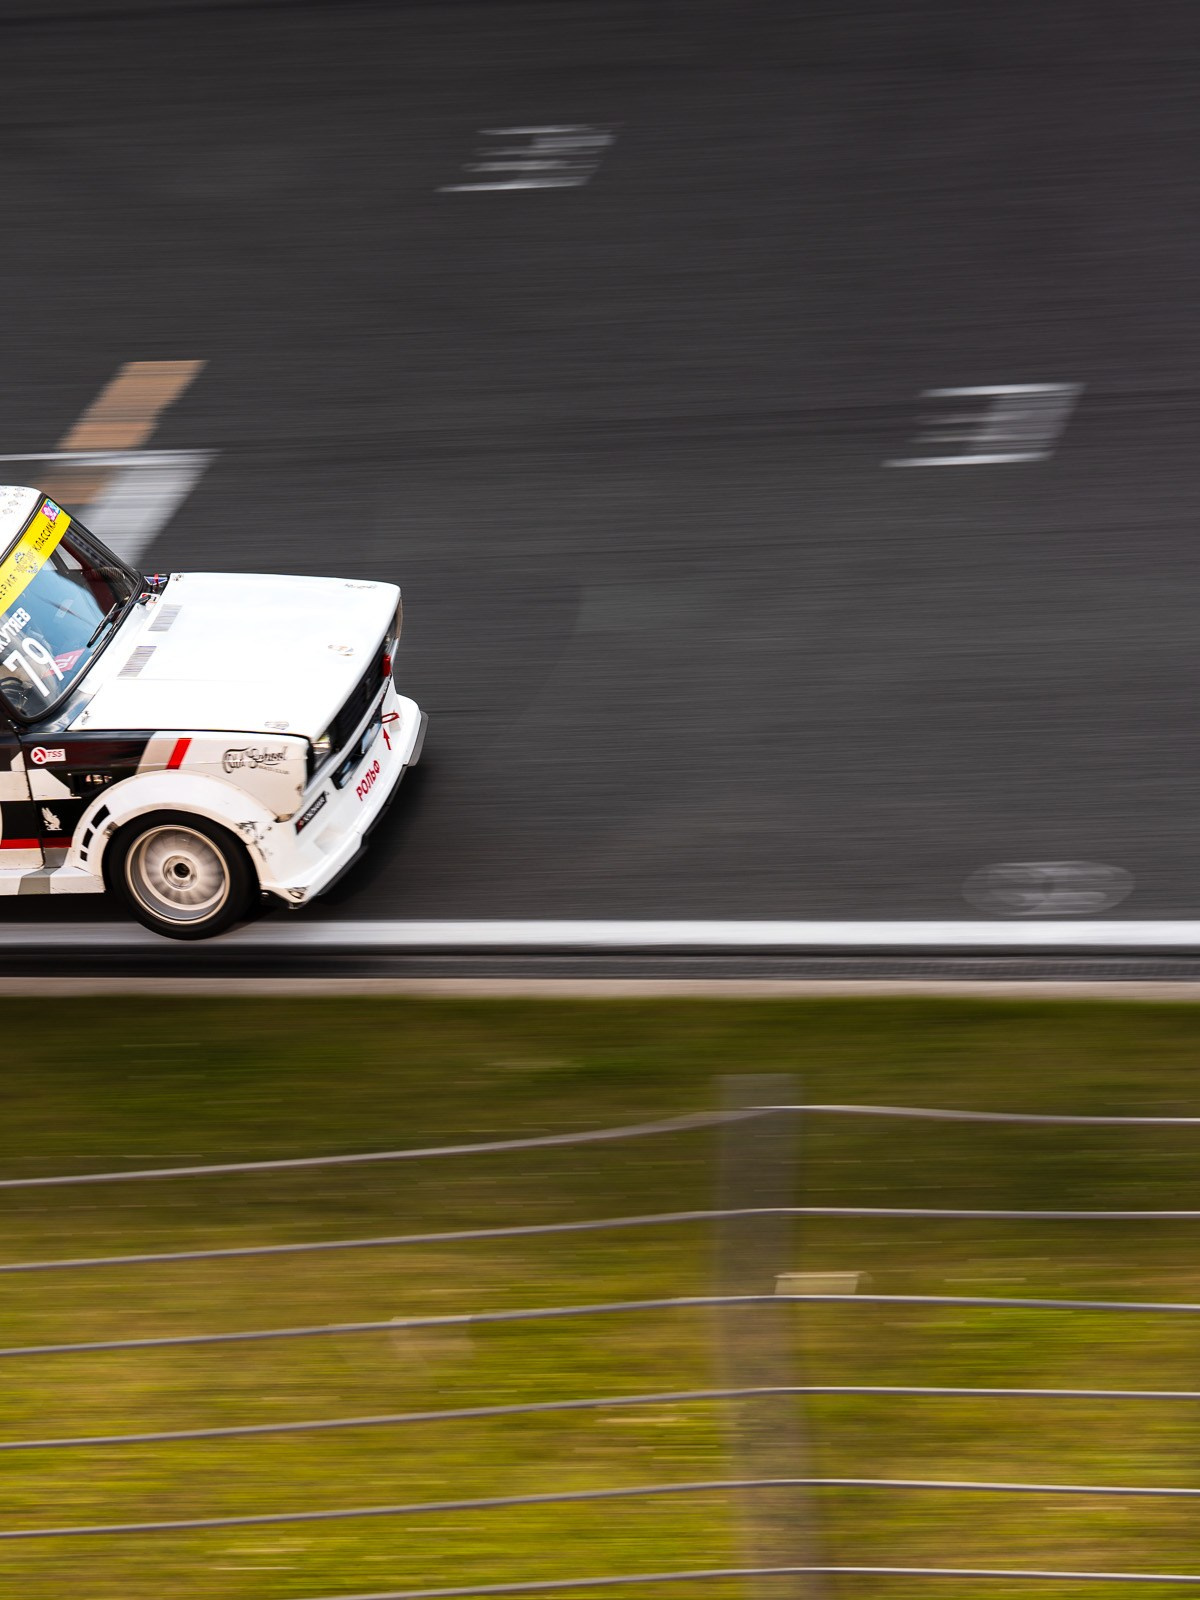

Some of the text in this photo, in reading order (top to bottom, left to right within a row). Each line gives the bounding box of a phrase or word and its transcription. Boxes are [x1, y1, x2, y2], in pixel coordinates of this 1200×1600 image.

[32, 519, 58, 553] КЛАССИКА
[2, 637, 65, 698] 79
[47, 750, 63, 758] TSS
[356, 760, 381, 801] РОЛЬФ
